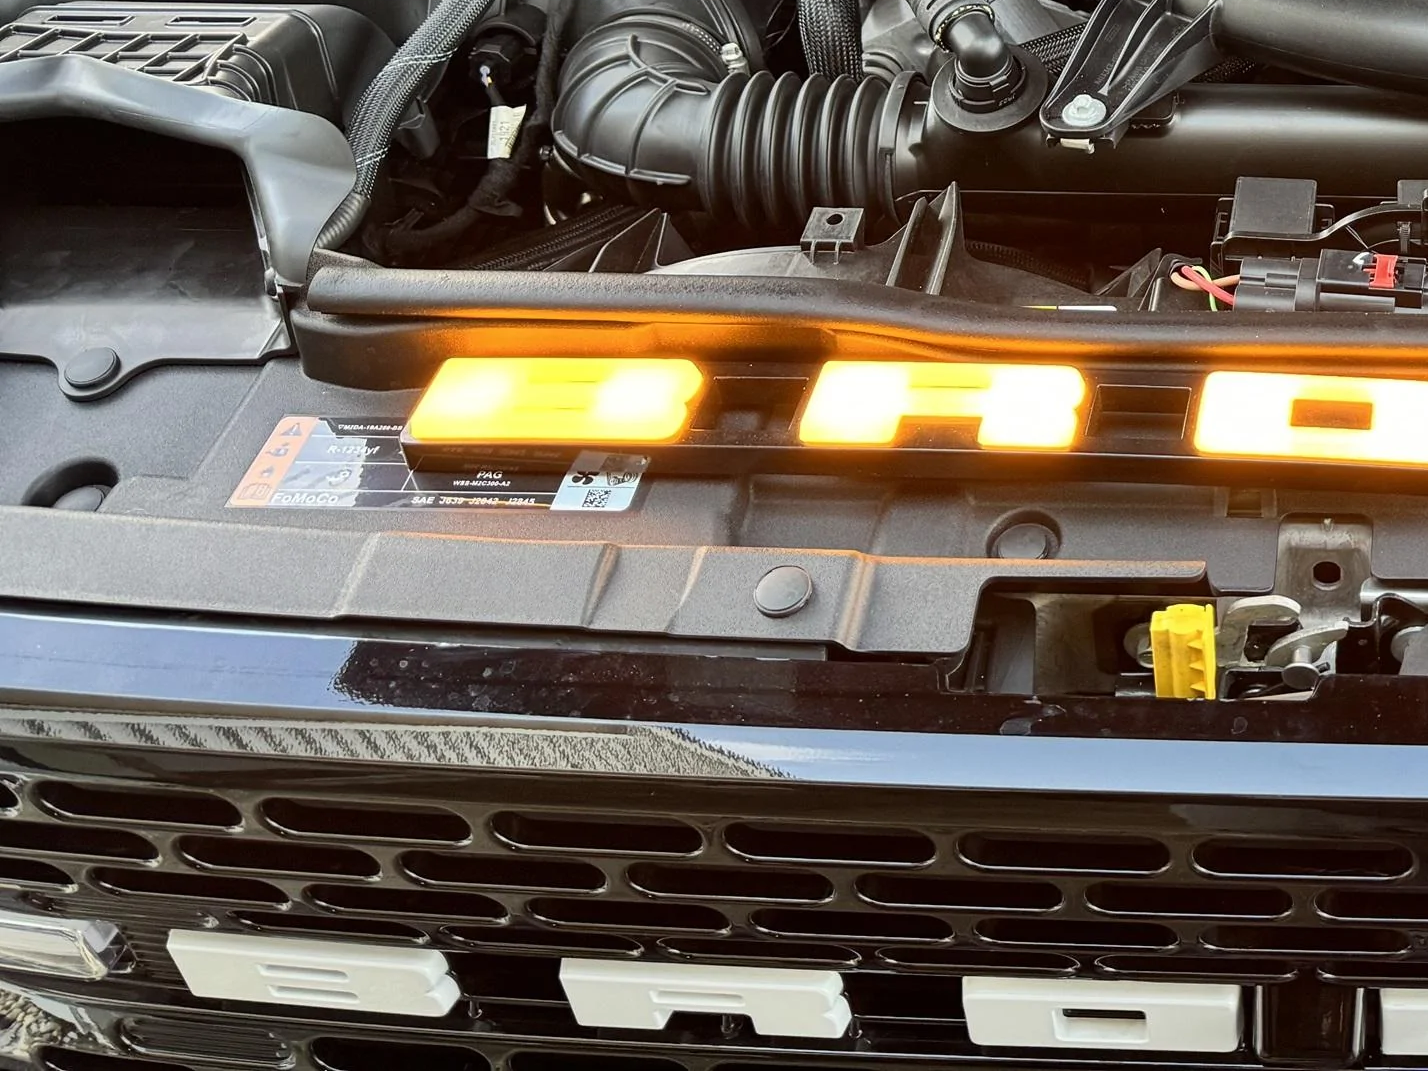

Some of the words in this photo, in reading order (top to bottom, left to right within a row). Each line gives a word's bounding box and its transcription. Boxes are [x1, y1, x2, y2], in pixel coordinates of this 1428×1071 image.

[327, 445, 380, 456] R-1234yf
[476, 470, 503, 479] PAG
[271, 492, 339, 505] FoMoCo
[411, 496, 435, 504] SAE
